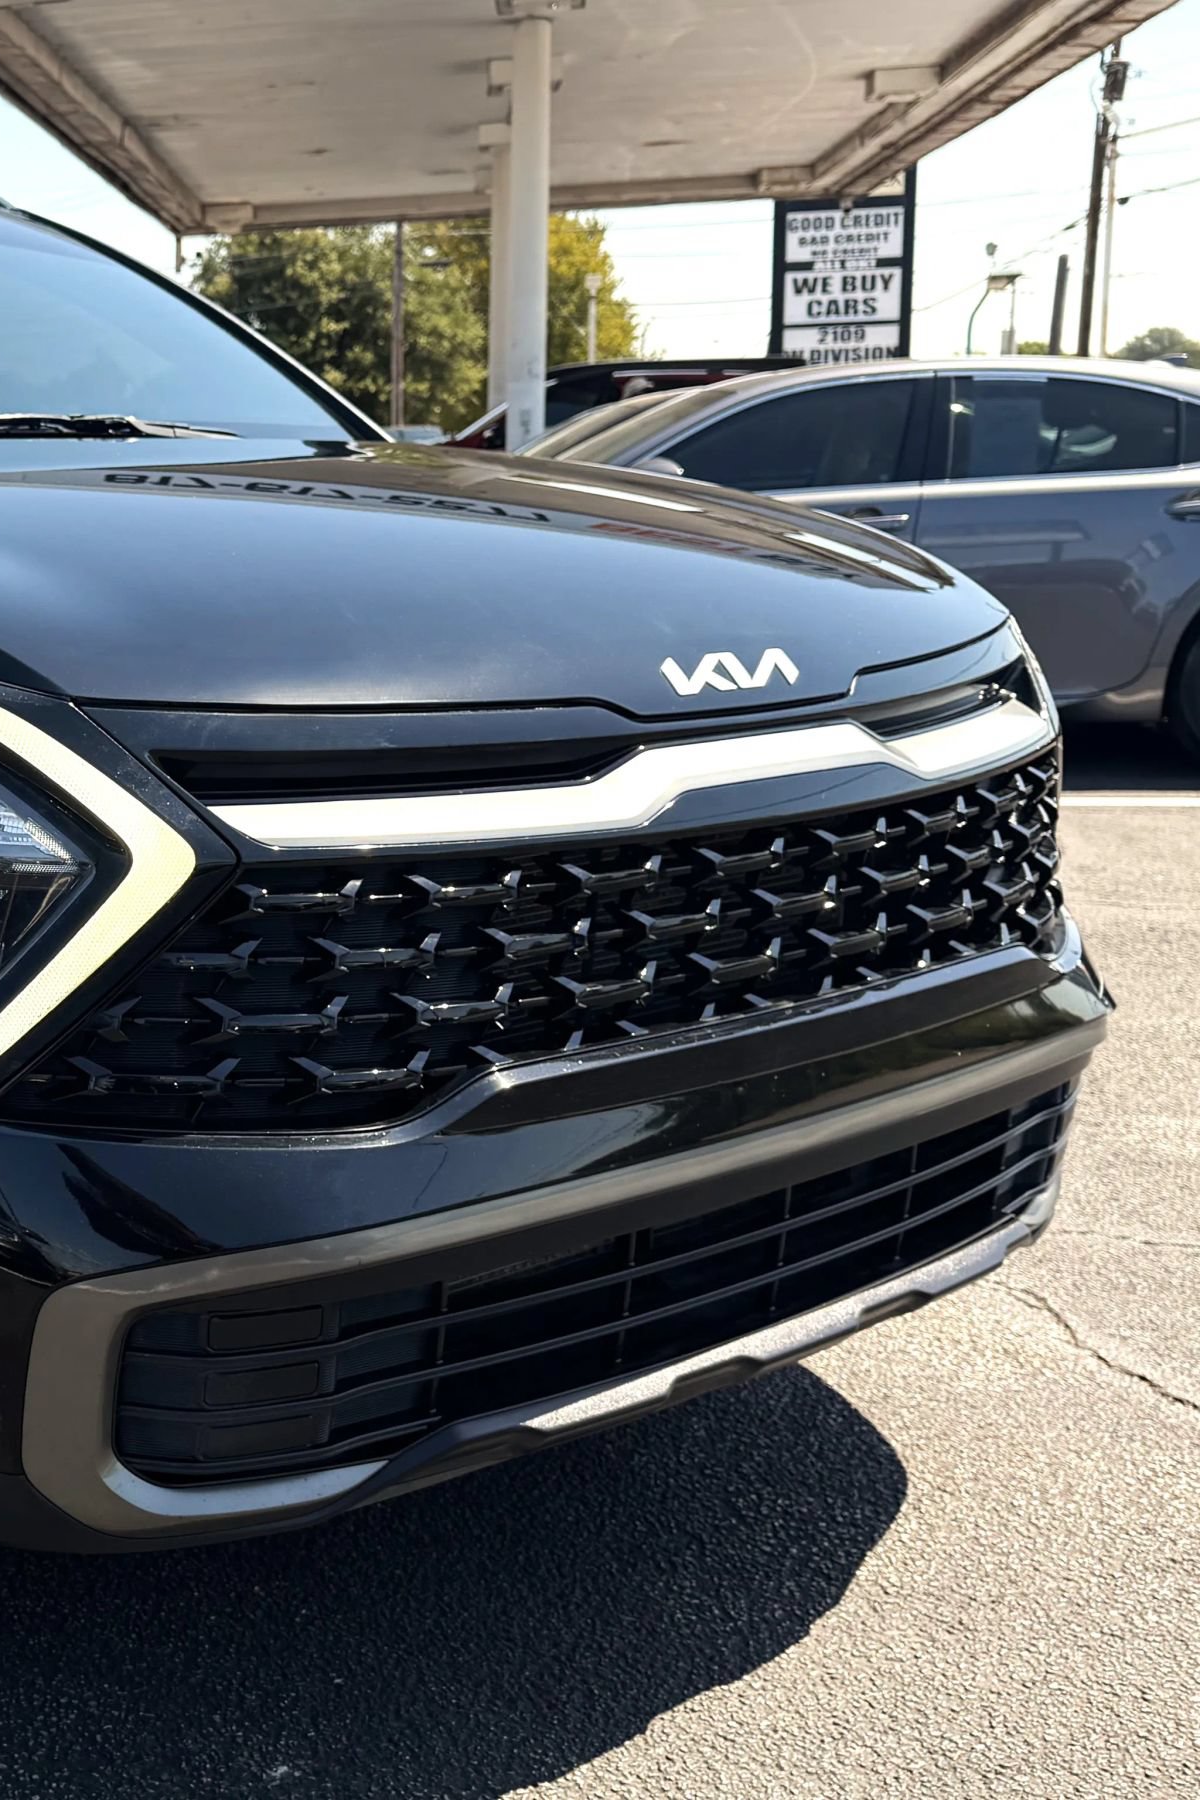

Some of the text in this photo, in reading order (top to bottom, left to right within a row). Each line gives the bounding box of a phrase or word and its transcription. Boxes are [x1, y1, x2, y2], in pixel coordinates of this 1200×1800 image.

[787, 212, 901, 232] GOOD CREDIT
[834, 231, 891, 245] CREDIT
[792, 273, 894, 295] WE BUY
[807, 297, 878, 318] CARS
[817, 325, 866, 345] 2109
[809, 346, 899, 364] DIVISION
[659, 647, 800, 696] KIA
